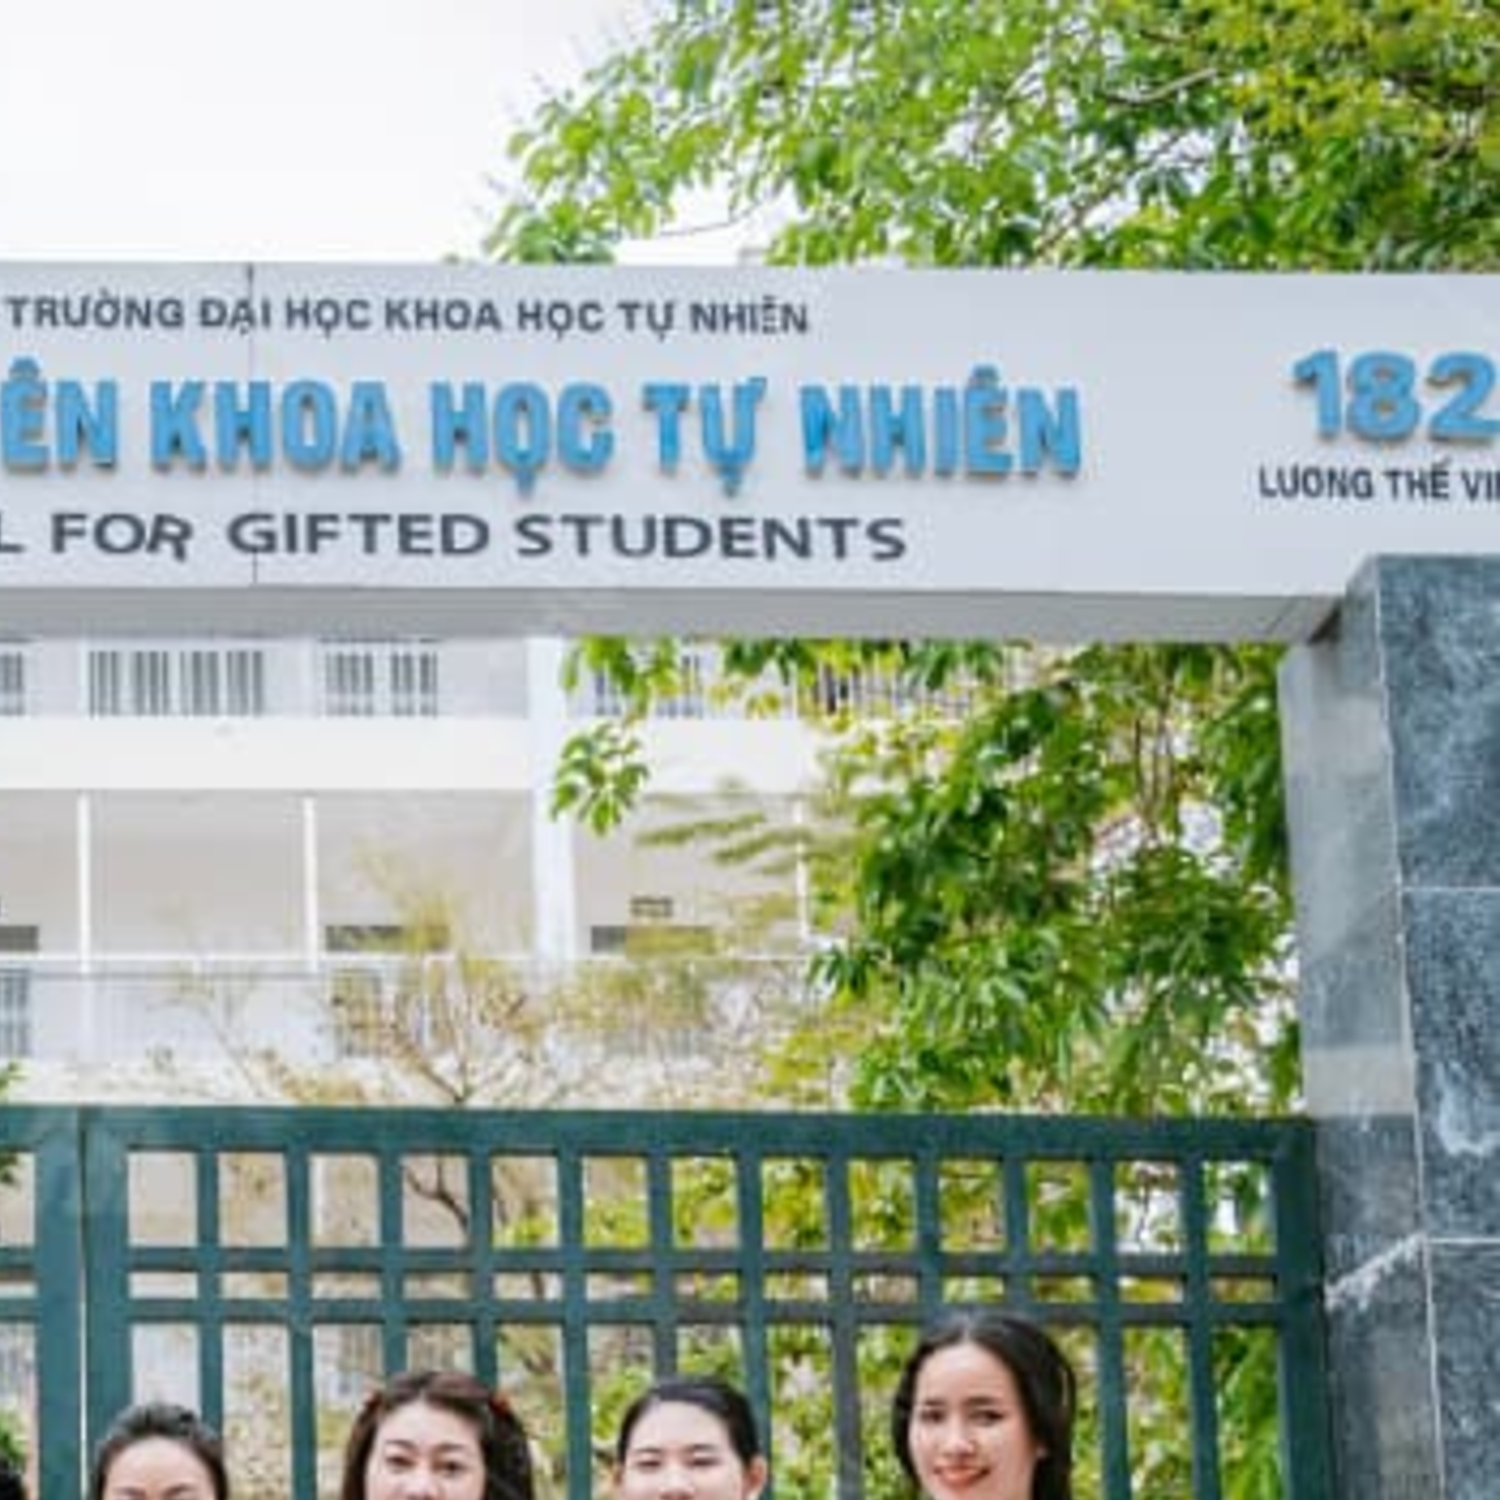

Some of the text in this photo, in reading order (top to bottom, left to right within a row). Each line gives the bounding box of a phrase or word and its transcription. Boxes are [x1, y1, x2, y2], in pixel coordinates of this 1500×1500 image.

[8, 289, 185, 330] TRƯỜNG
[199, 298, 272, 336] ĐẠI
[286, 298, 371, 339] HỌC
[384, 300, 503, 331] KHOA
[517, 300, 604, 340] HỌC
[616, 300, 676, 341] TỰ
[689, 294, 809, 335] NHIÊN
[148, 378, 403, 470] KHOA
[428, 380, 616, 495] HỌC
[642, 376, 767, 496] TỰ
[798, 365, 1084, 478] NHIÊN
[1291, 349, 1500, 441] 182
[51, 512, 194, 562] FOR
[227, 512, 490, 557] GIFTED
[514, 515, 907, 561] STUDENTS
